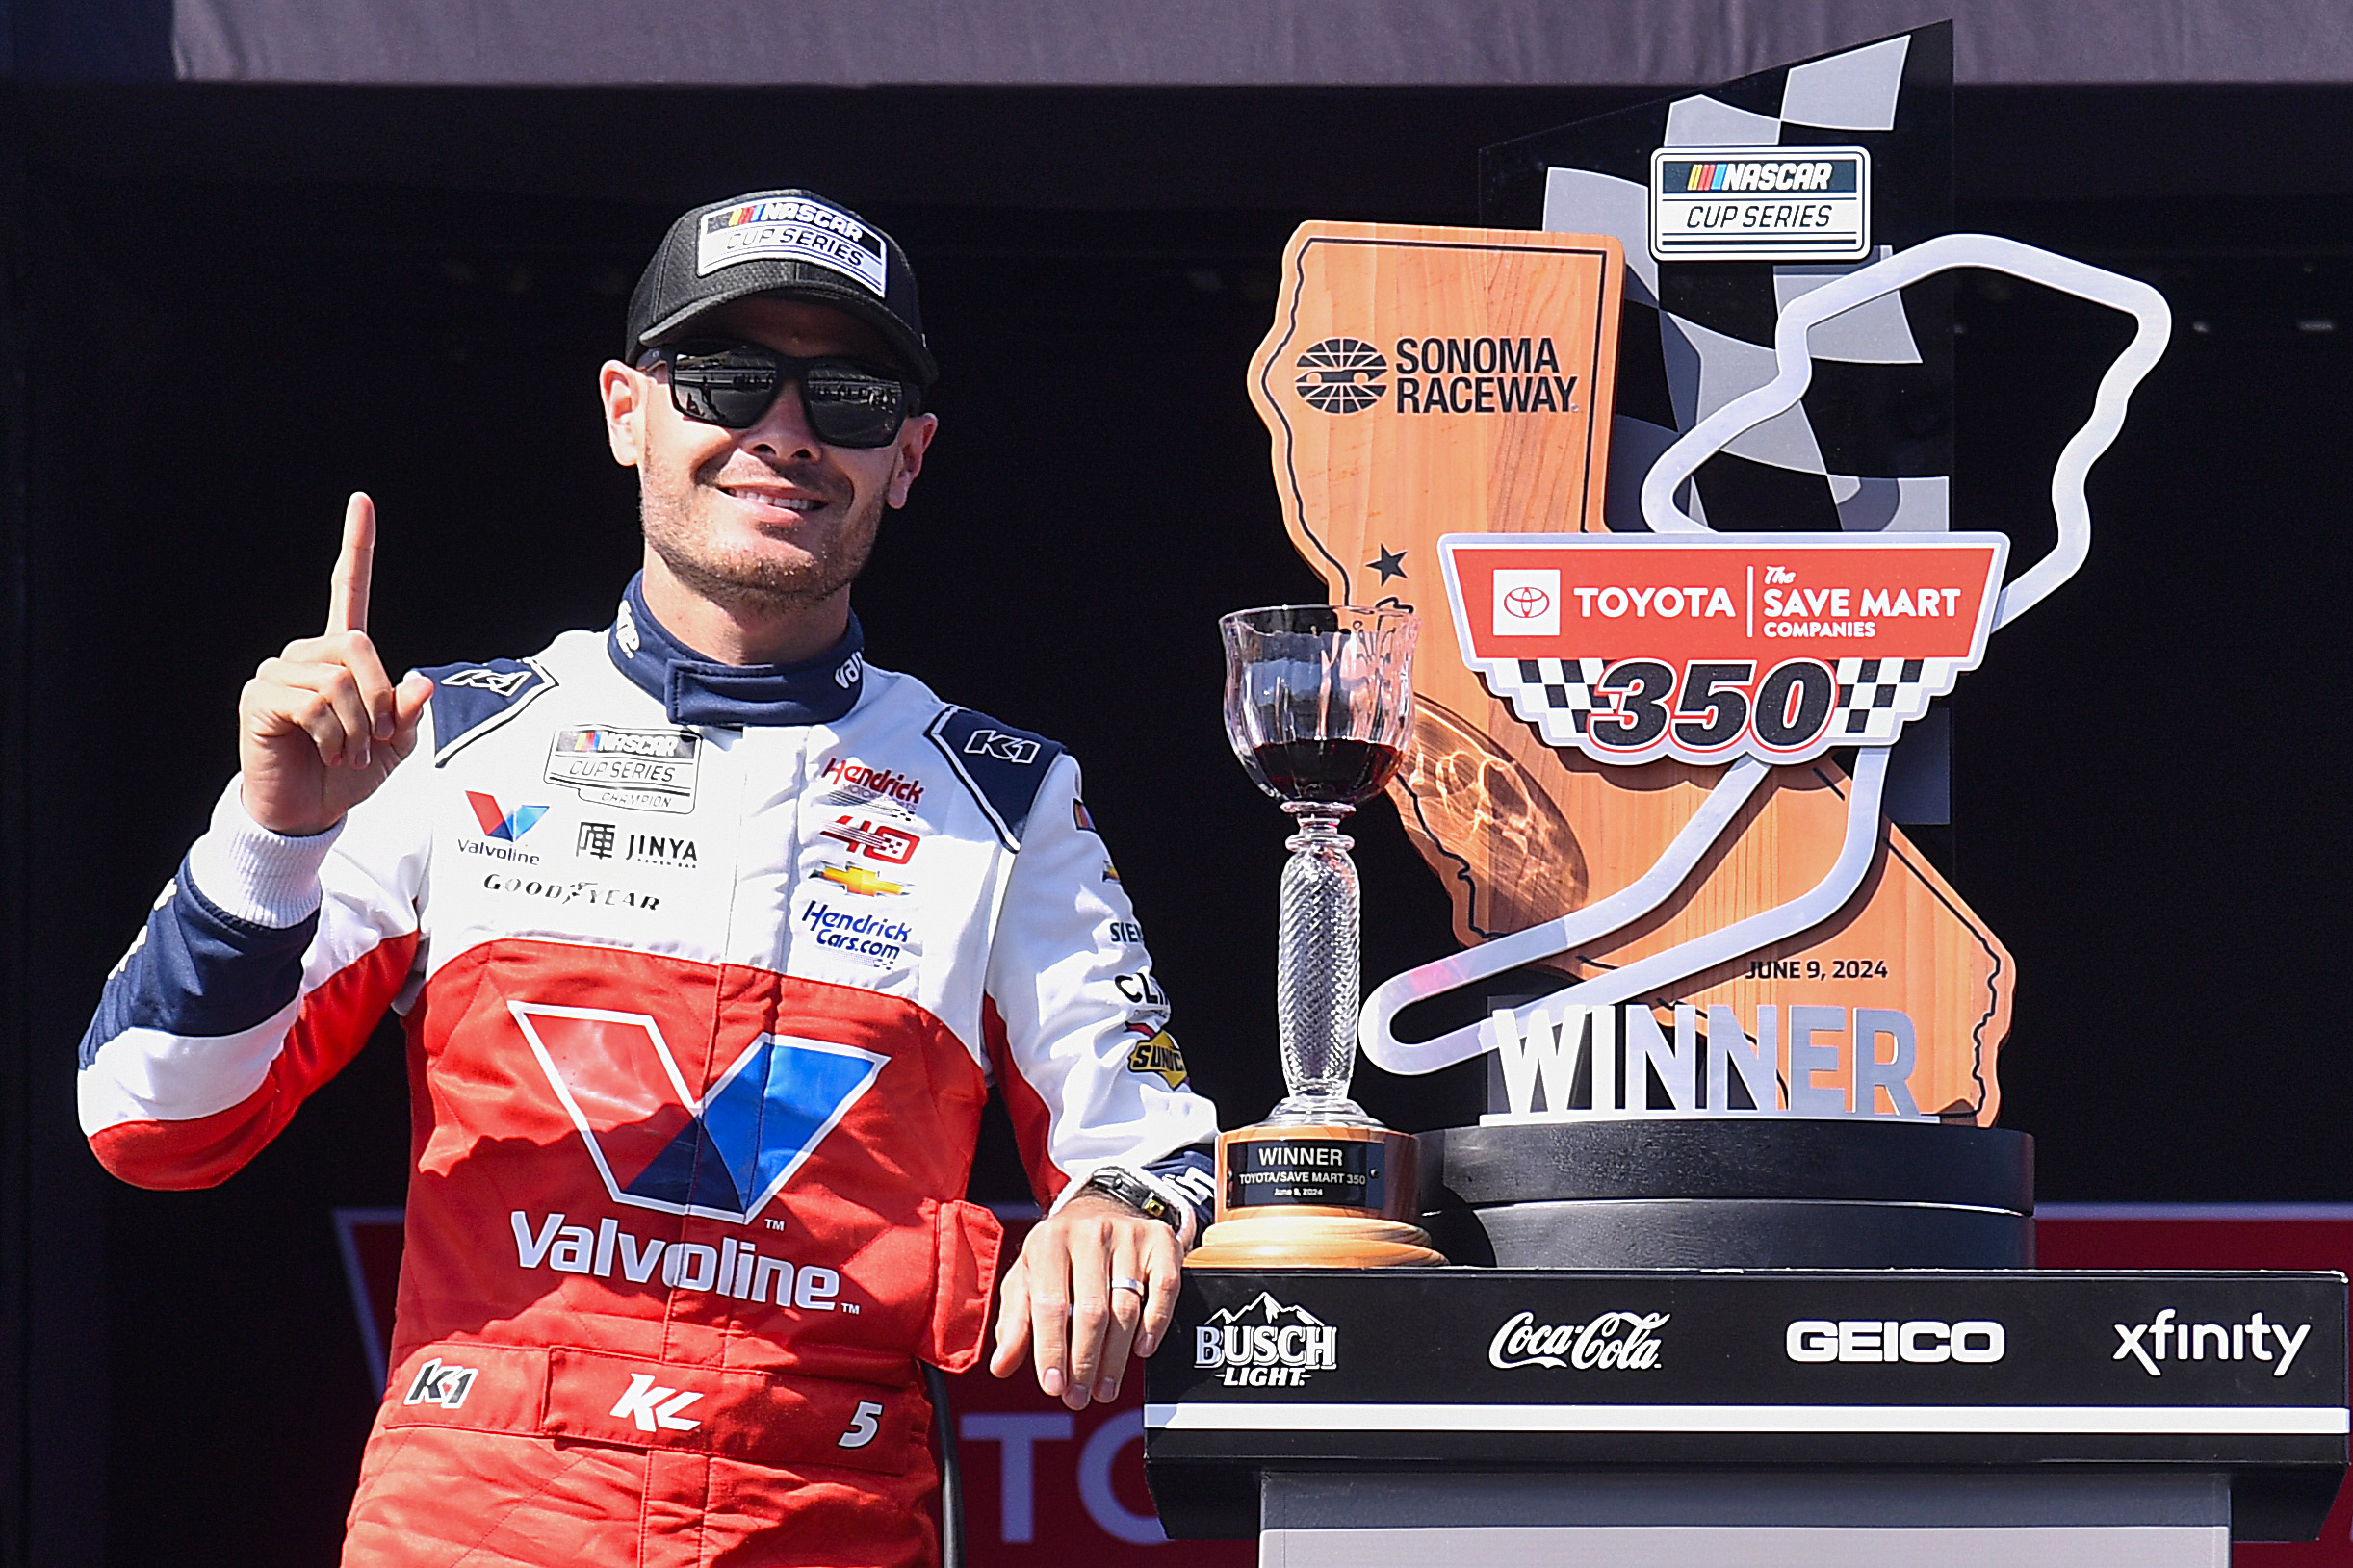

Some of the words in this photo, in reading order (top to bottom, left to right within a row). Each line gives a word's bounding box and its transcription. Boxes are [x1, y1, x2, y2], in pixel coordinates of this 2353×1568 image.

[1721, 162, 1833, 191] NASCAR
[760, 202, 864, 243] NASCAR
[1687, 205, 1738, 229] CUP
[1742, 204, 1833, 228] SERIES
[726, 228, 776, 250] CUP
[780, 228, 865, 267] SERIES
[1395, 337, 1561, 374] SONOMA
[1396, 375, 1578, 414] RACEWAY
[1763, 565, 1797, 585] The
[1573, 586, 1736, 618] TOYOTA
[1763, 588, 1850, 618] SAVE
[1859, 588, 1962, 618] MART
[1763, 621, 1876, 638] COMPANIES
[1588, 658, 1838, 752] 350
[597, 731, 680, 758] NASCAR
[964, 729, 1041, 764] K1
[569, 760, 608, 777] CUP
[609, 760, 676, 783] SERIES
[820, 757, 925, 804] Hendrick
[601, 791, 672, 808] CHAMPION
[457, 838, 540, 866] Valvoline
[625, 834, 698, 861] JINYA
[483, 873, 660, 911] GOODYEAR
[801, 899, 913, 943] Hendrick
[816, 928, 901, 960] Cars.com
[1745, 960, 1801, 980] JUNE
[1806, 960, 1827, 981] 9,
[1831, 960, 1888, 979] 2024
[1491, 1004, 1923, 1117] WINNER
[1258, 1146, 1343, 1166] WINNER
[1238, 1170, 1309, 1185] TOYOTA/SAVE
[1311, 1171, 1345, 1184] MART
[1346, 1173, 1366, 1186] 350
[1274, 1187, 1292, 1196] June
[1302, 1188, 1323, 1196] 2024
[763, 1218, 786, 1232] TM
[510, 1210, 841, 1311] Valvoline
[840, 1302, 861, 1316] TM
[1193, 1324, 1338, 1371] BUSCH
[1488, 1310, 1671, 1370] Coca-Cola
[1785, 1320, 2006, 1363] GEICO
[2111, 1307, 2313, 1377] xfinity
[402, 1356, 479, 1409] K1
[608, 1372, 705, 1432] KL
[838, 1401, 884, 1450] 5
